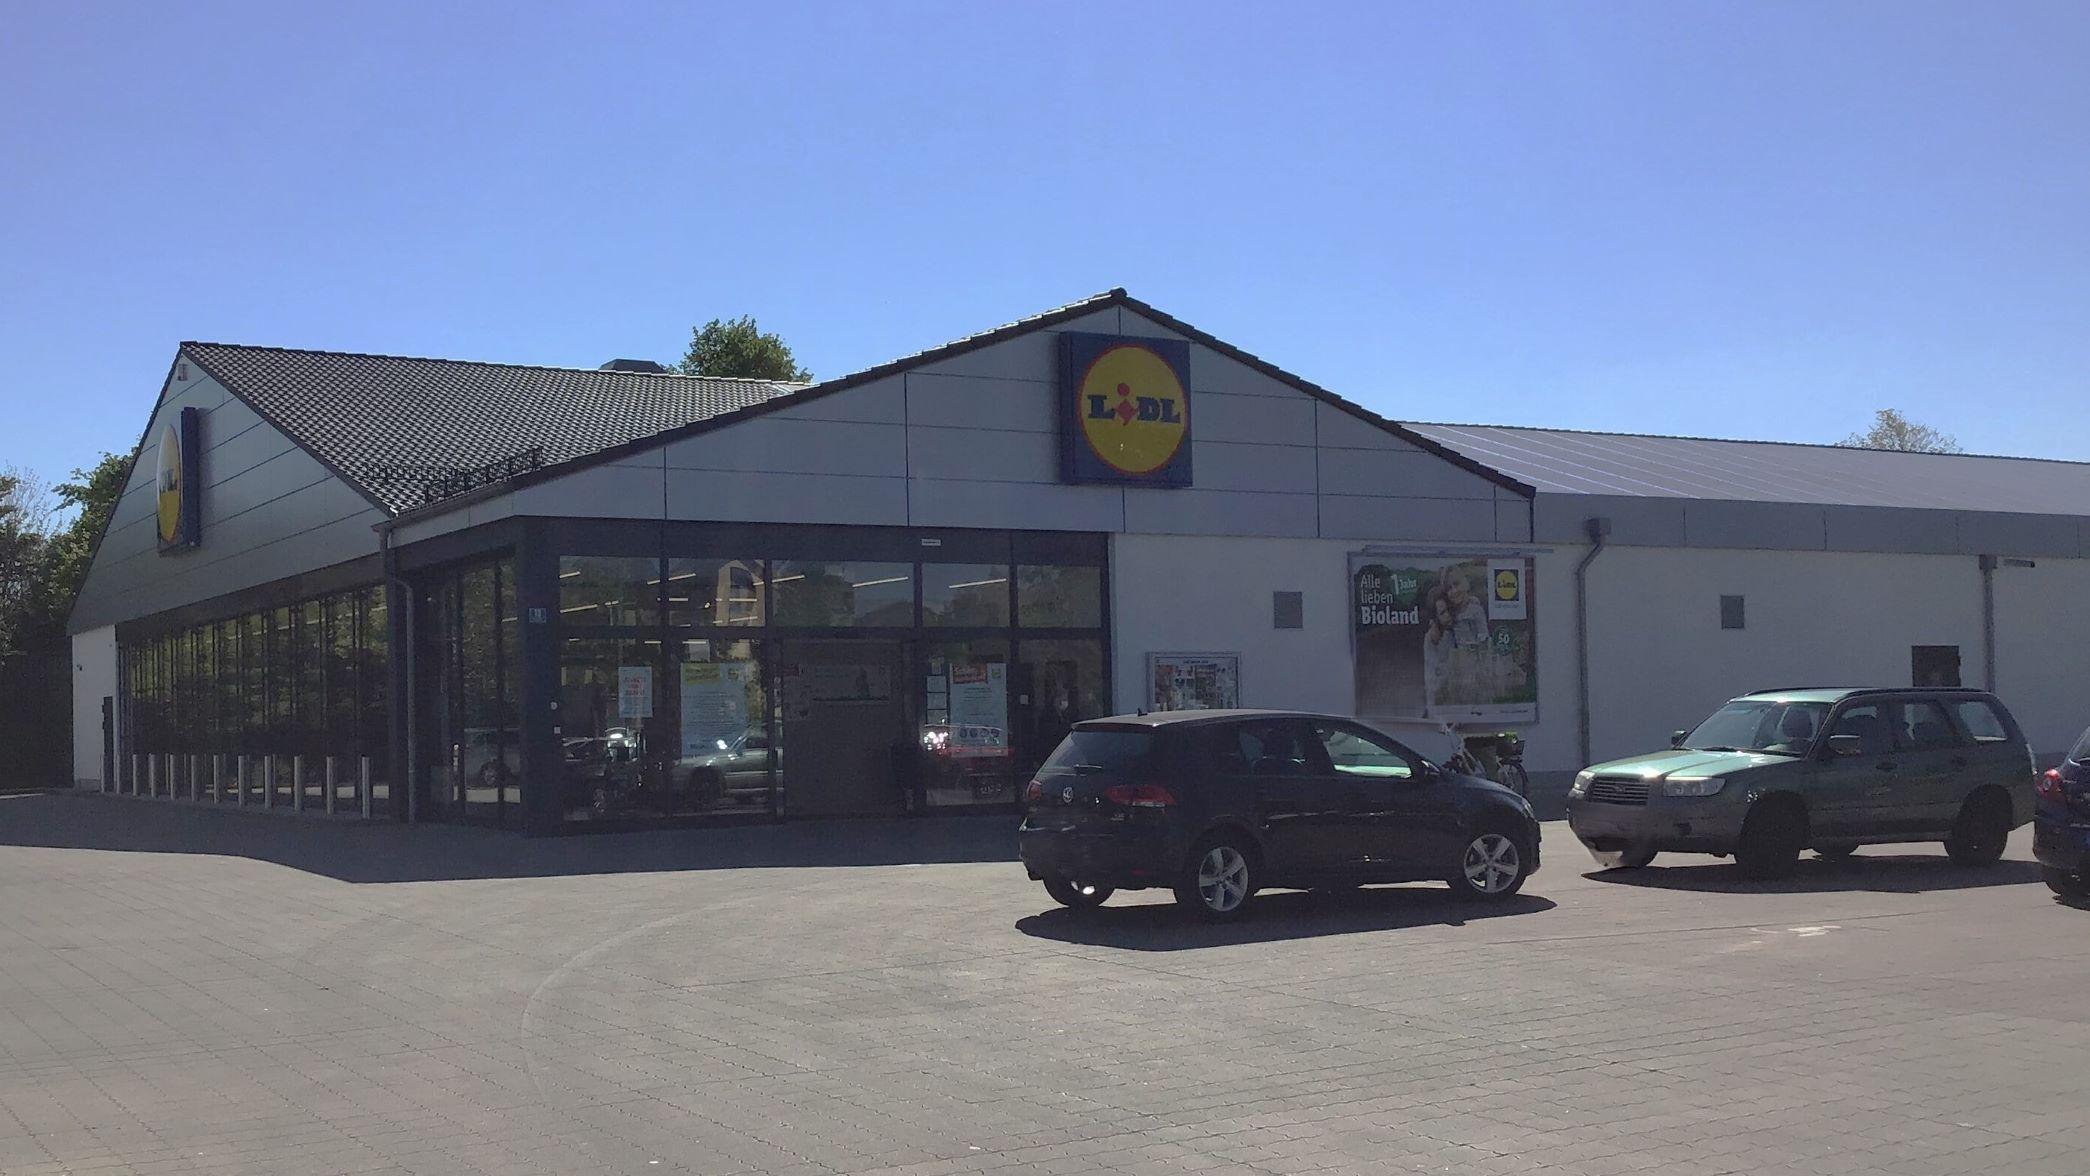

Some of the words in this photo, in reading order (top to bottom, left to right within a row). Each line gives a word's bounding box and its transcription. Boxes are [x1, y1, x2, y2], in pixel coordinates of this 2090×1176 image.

[1360, 574, 1381, 589] Alle
[1360, 589, 1394, 604] lieben
[1360, 605, 1420, 625] Bioland
